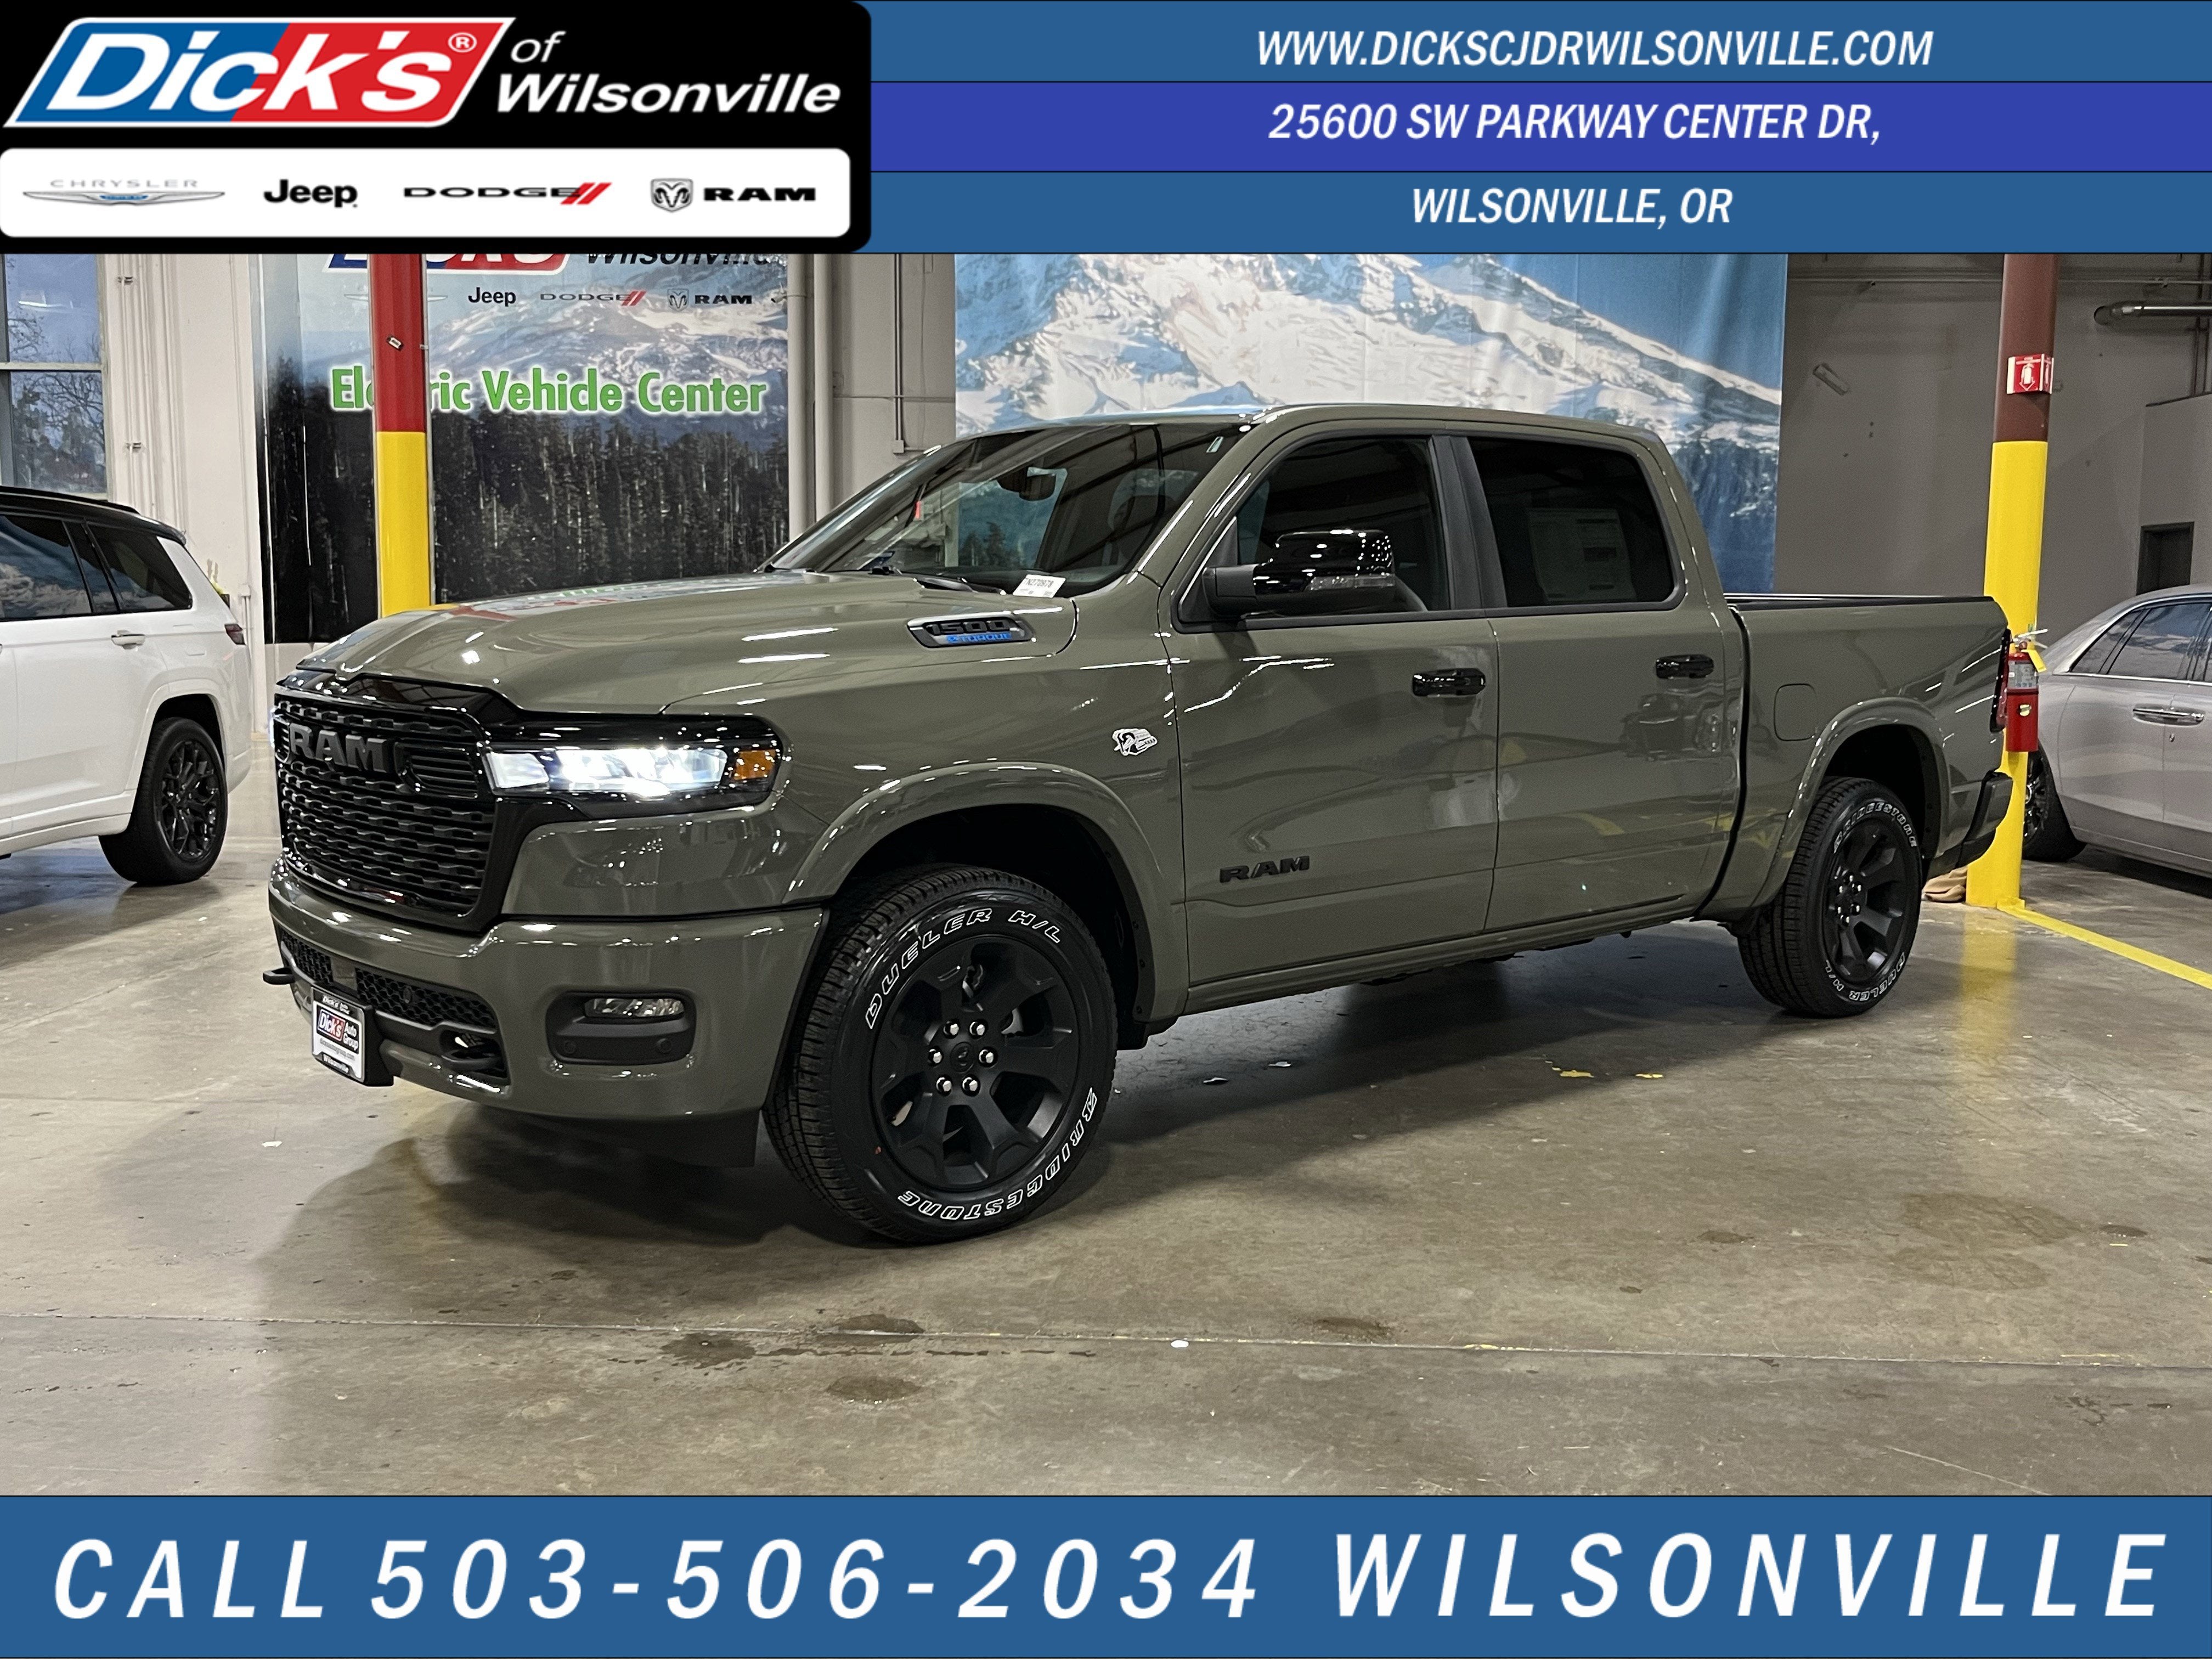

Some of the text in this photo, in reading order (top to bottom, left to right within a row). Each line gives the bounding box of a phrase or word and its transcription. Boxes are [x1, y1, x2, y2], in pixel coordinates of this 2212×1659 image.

[468, 287, 516, 307] Jeep
[695, 295, 752, 305] RAM
[482, 368, 622, 411] Vehicle
[639, 371, 766, 412] Center
[926, 619, 1011, 635] 1500
[289, 723, 389, 774] RAM
[1220, 855, 1310, 883] RAM
[865, 907, 1061, 1030] DUELER H/L
[319, 1012, 342, 1037] Dick's
[897, 1086, 1098, 1221] BRIDGESTONE
